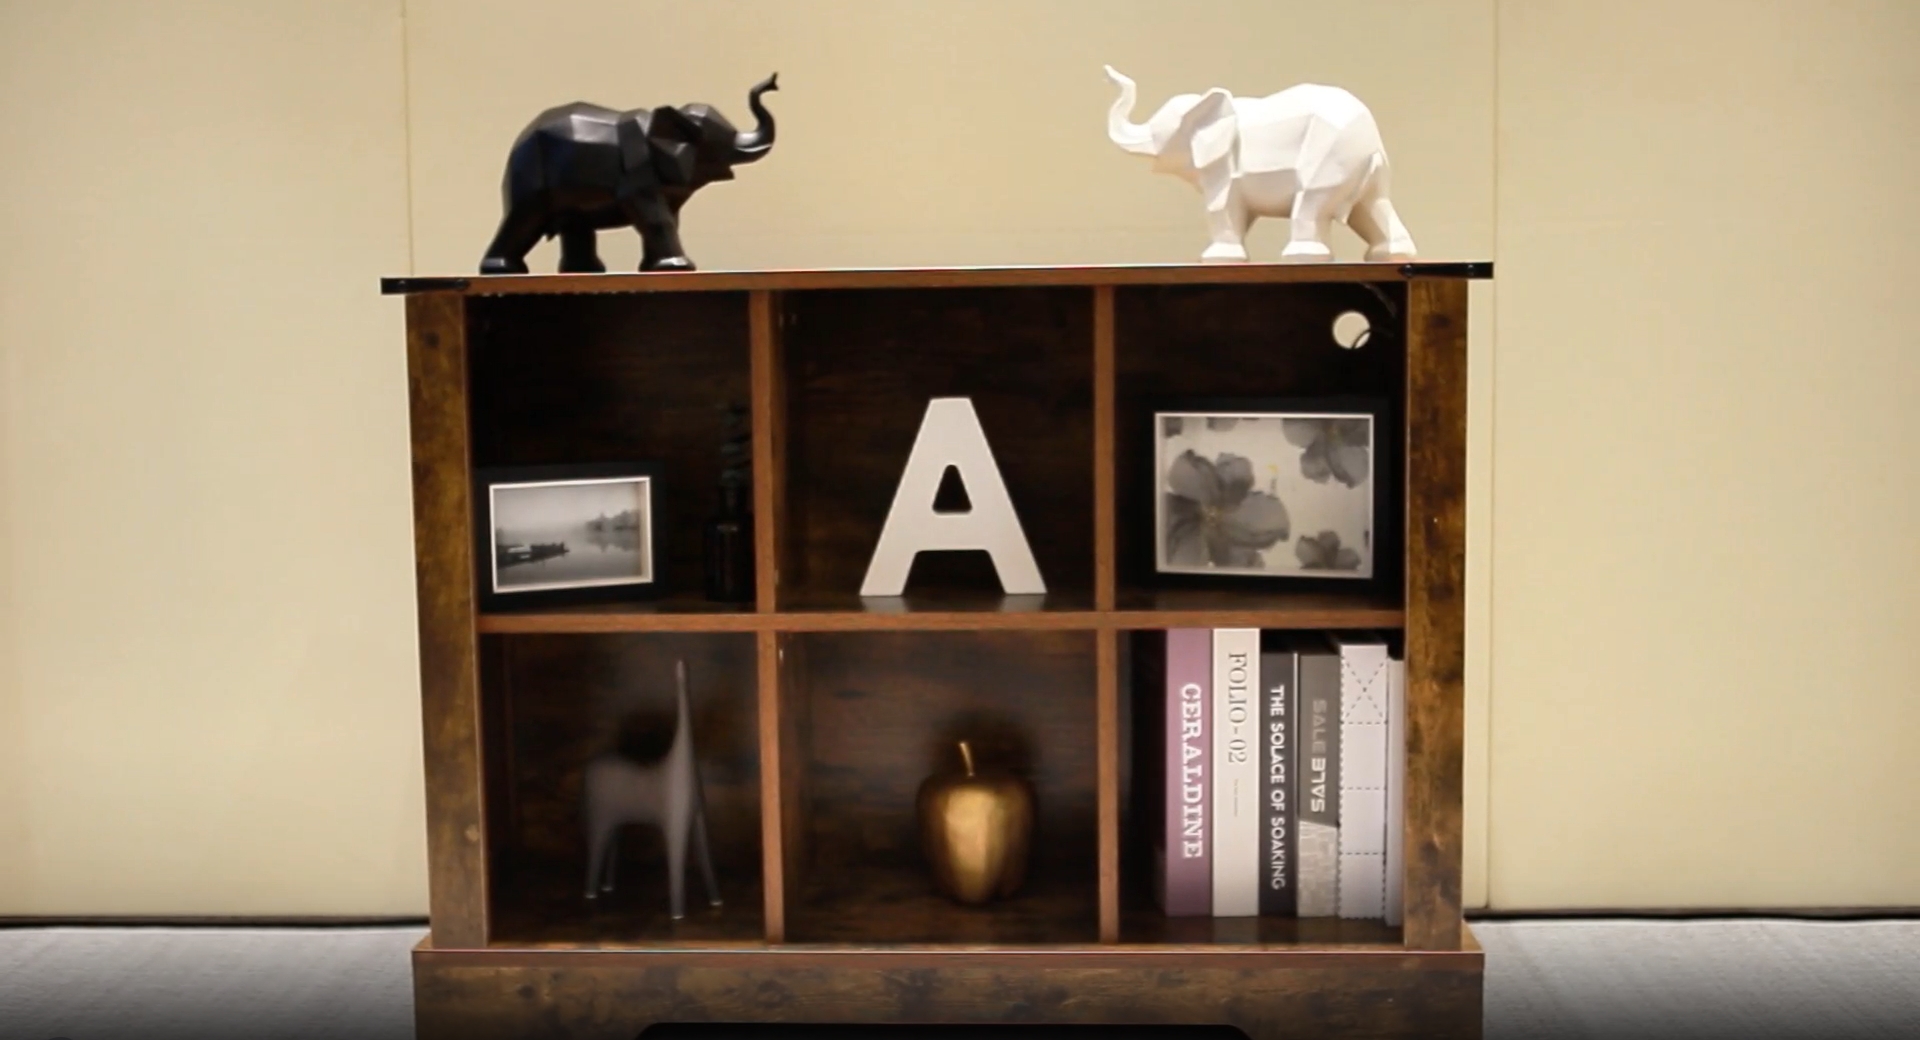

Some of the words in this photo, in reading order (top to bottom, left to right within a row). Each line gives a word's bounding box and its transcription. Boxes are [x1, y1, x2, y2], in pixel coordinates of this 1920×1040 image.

[859, 397, 1047, 596] A
[1270, 685, 1285, 716] THE
[1312, 699, 1327, 754] SALE
[1181, 683, 1204, 858] CERALDINE
[1270, 723, 1286, 784] SOLACE
[1271, 790, 1286, 811] OF
[1311, 758, 1326, 812] SALE
[1271, 817, 1286, 890] SOAKING
